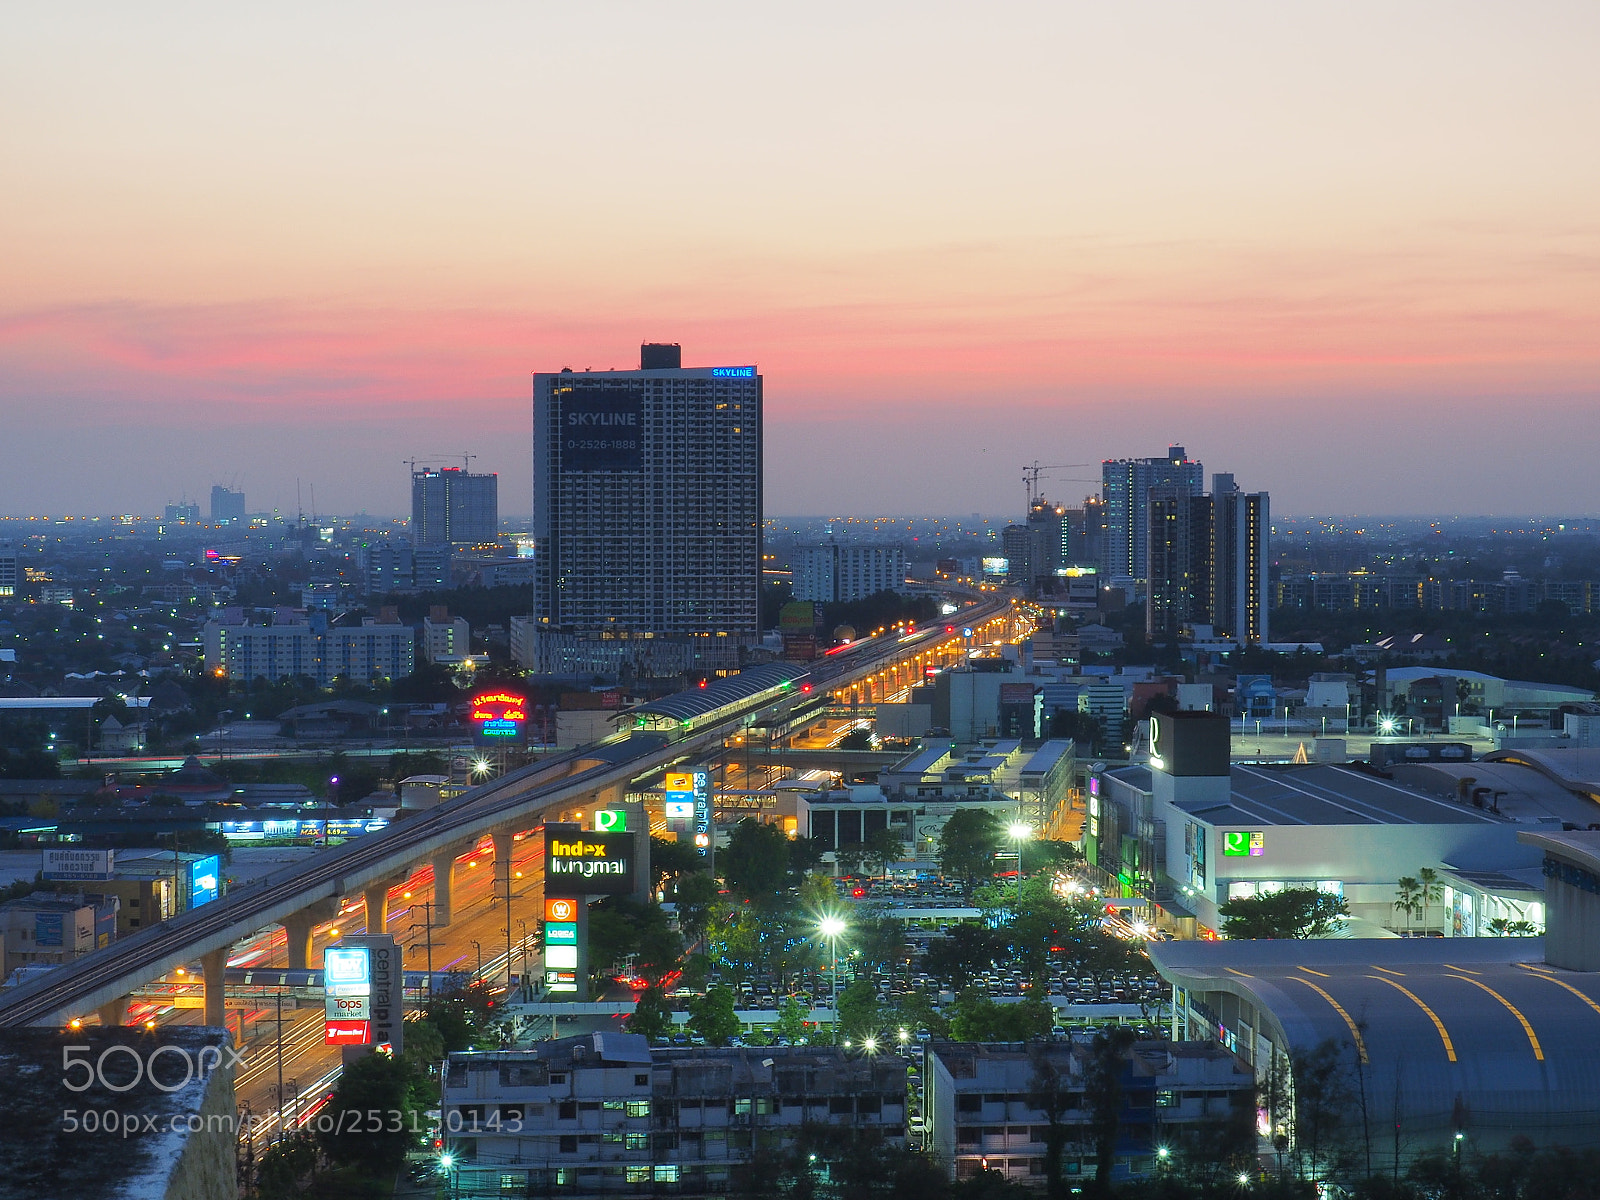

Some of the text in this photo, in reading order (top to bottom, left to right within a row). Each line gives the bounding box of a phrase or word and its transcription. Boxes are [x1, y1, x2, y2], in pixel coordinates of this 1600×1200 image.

[712, 367, 752, 377] SKYLINE
[568, 412, 636, 426] SKYLINE
[567, 439, 636, 449] 0-2526-1888
[552, 840, 606, 857] Index
[552, 857, 627, 877] livingmall
[334, 998, 362, 1011] Tops
